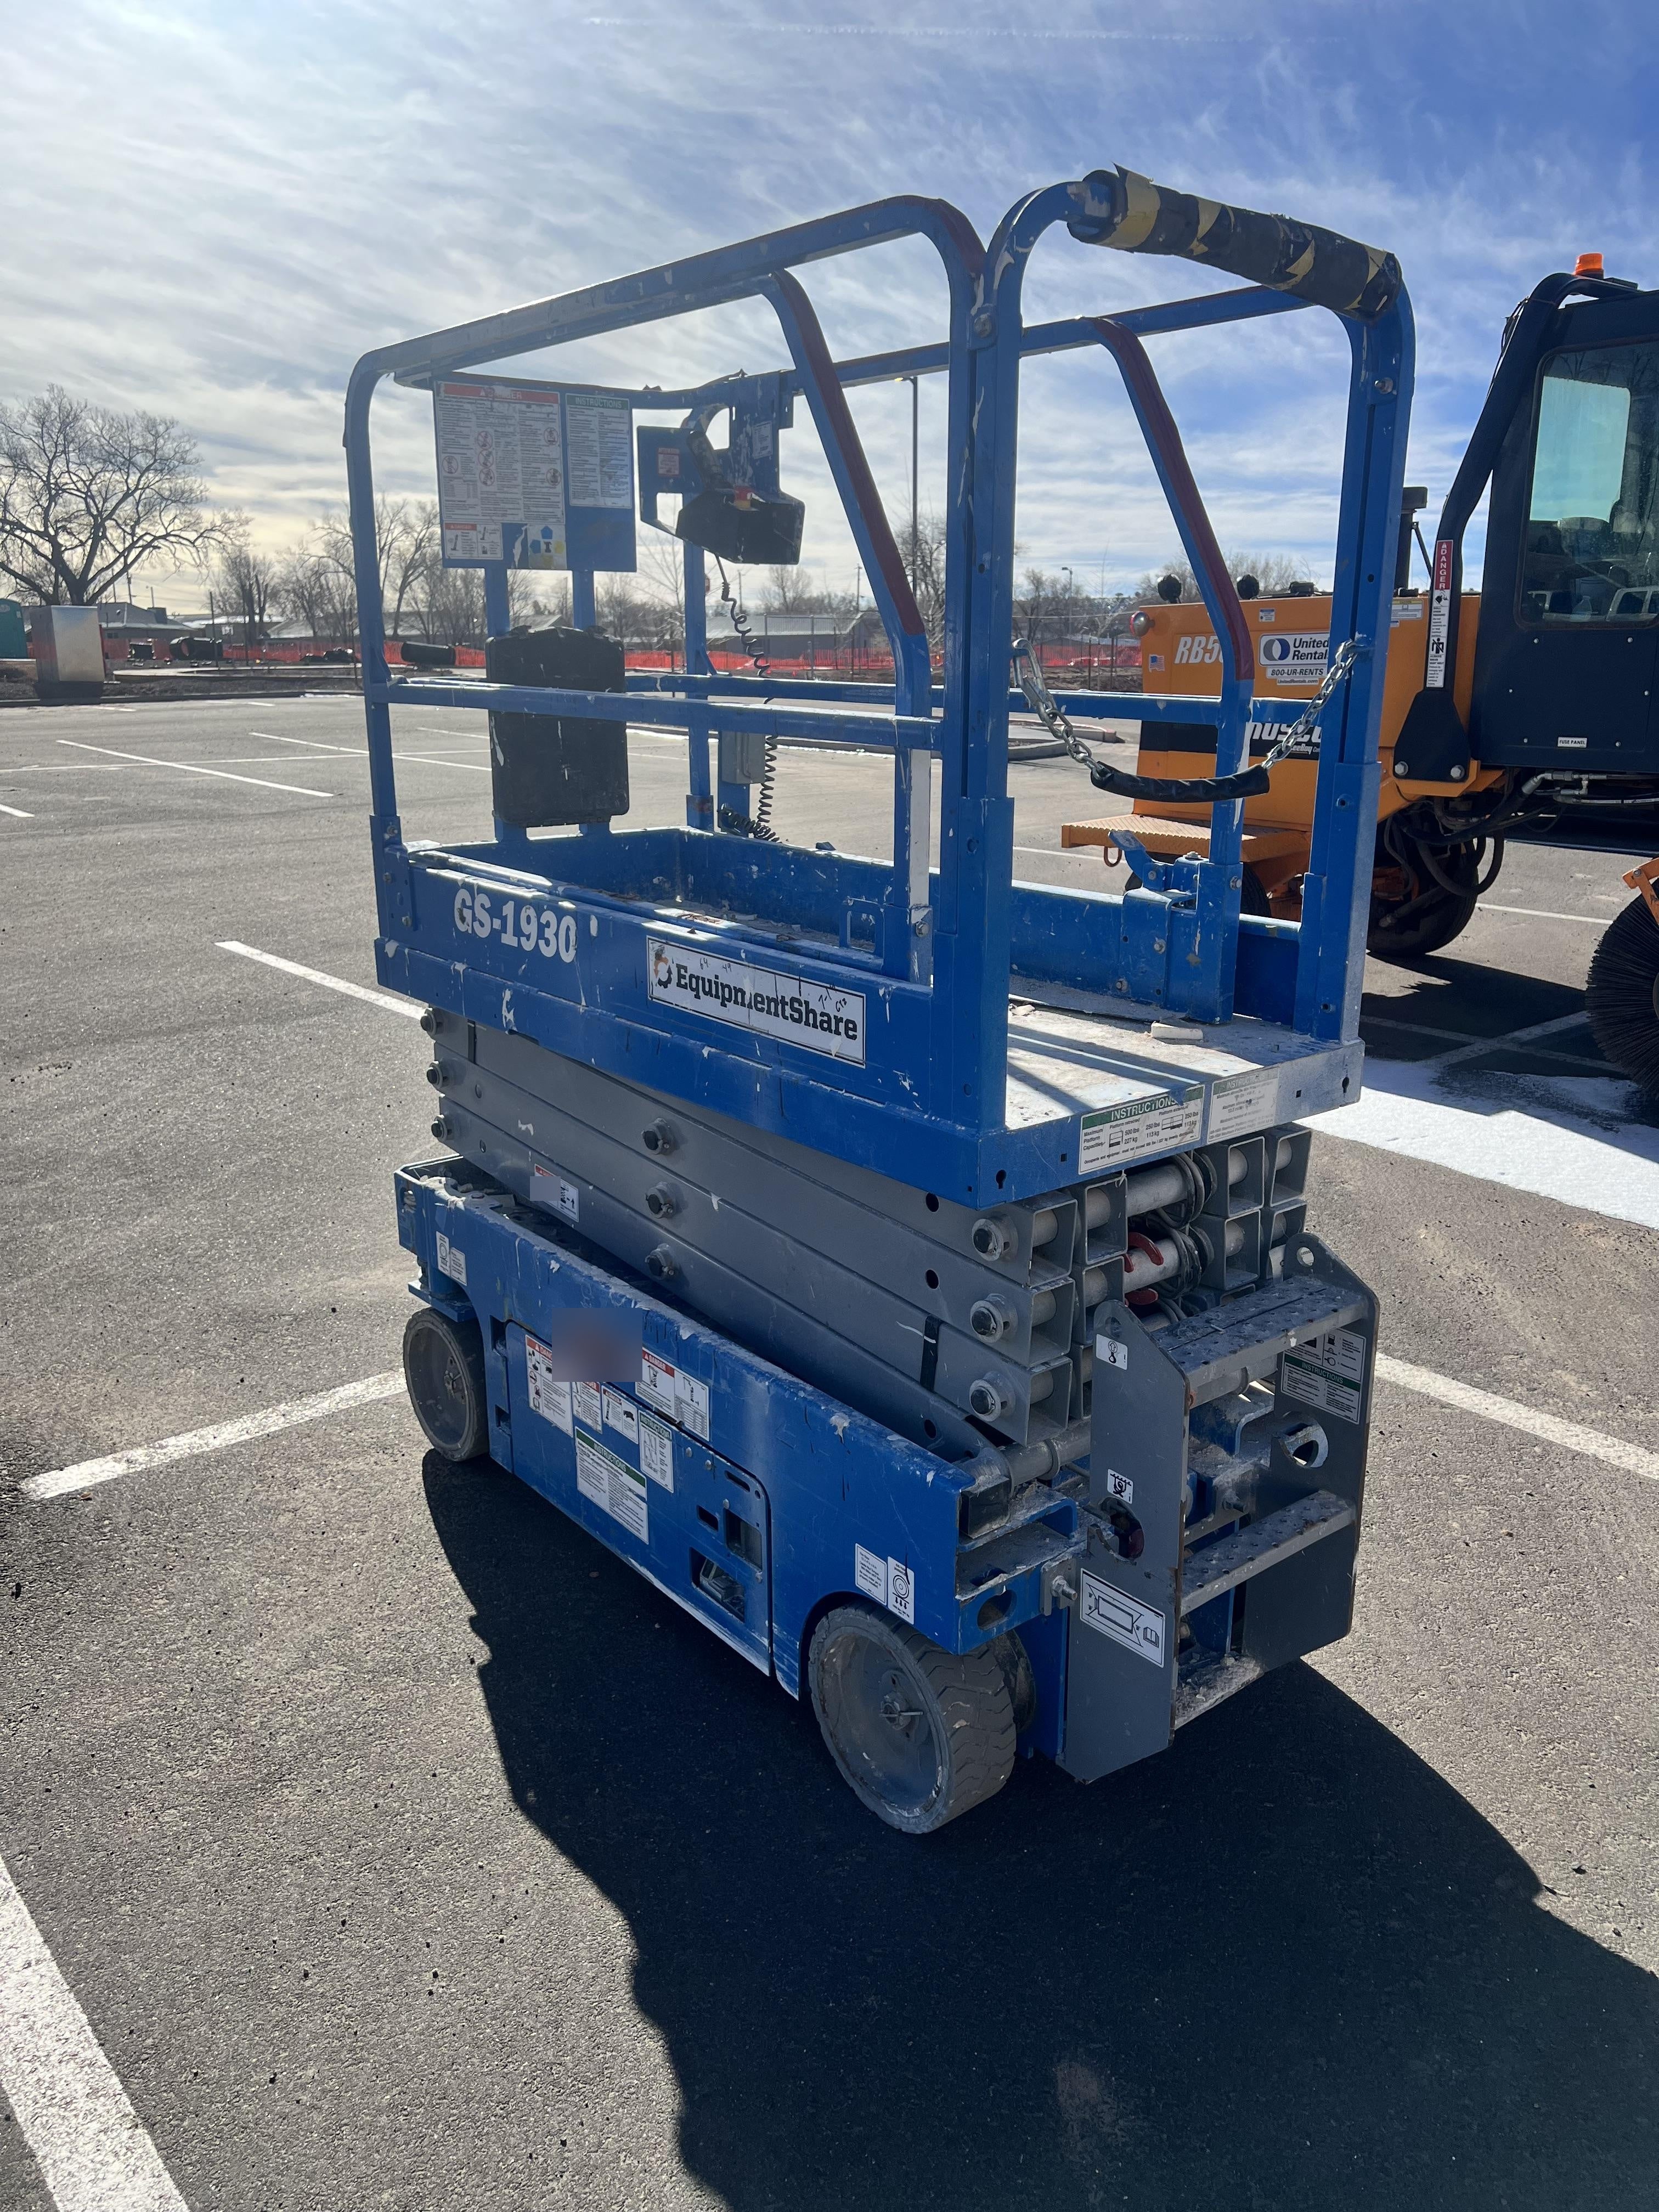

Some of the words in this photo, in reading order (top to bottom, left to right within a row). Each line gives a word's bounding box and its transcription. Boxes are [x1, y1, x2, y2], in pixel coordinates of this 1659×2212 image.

[575, 396, 622, 409] INSTRUCTIONS
[1439, 549, 1447, 589] DANGER
[454, 888, 577, 963] GS-1930
[676, 963, 857, 1040] EquipmentShare
[1084, 1128, 1103, 1137] Maximum
[649, 1354, 666, 1370] DANGER
[1301, 1362, 1344, 1384] INSTRUCTIONS
[594, 1442, 627, 1472] INSTRUCTIONS
